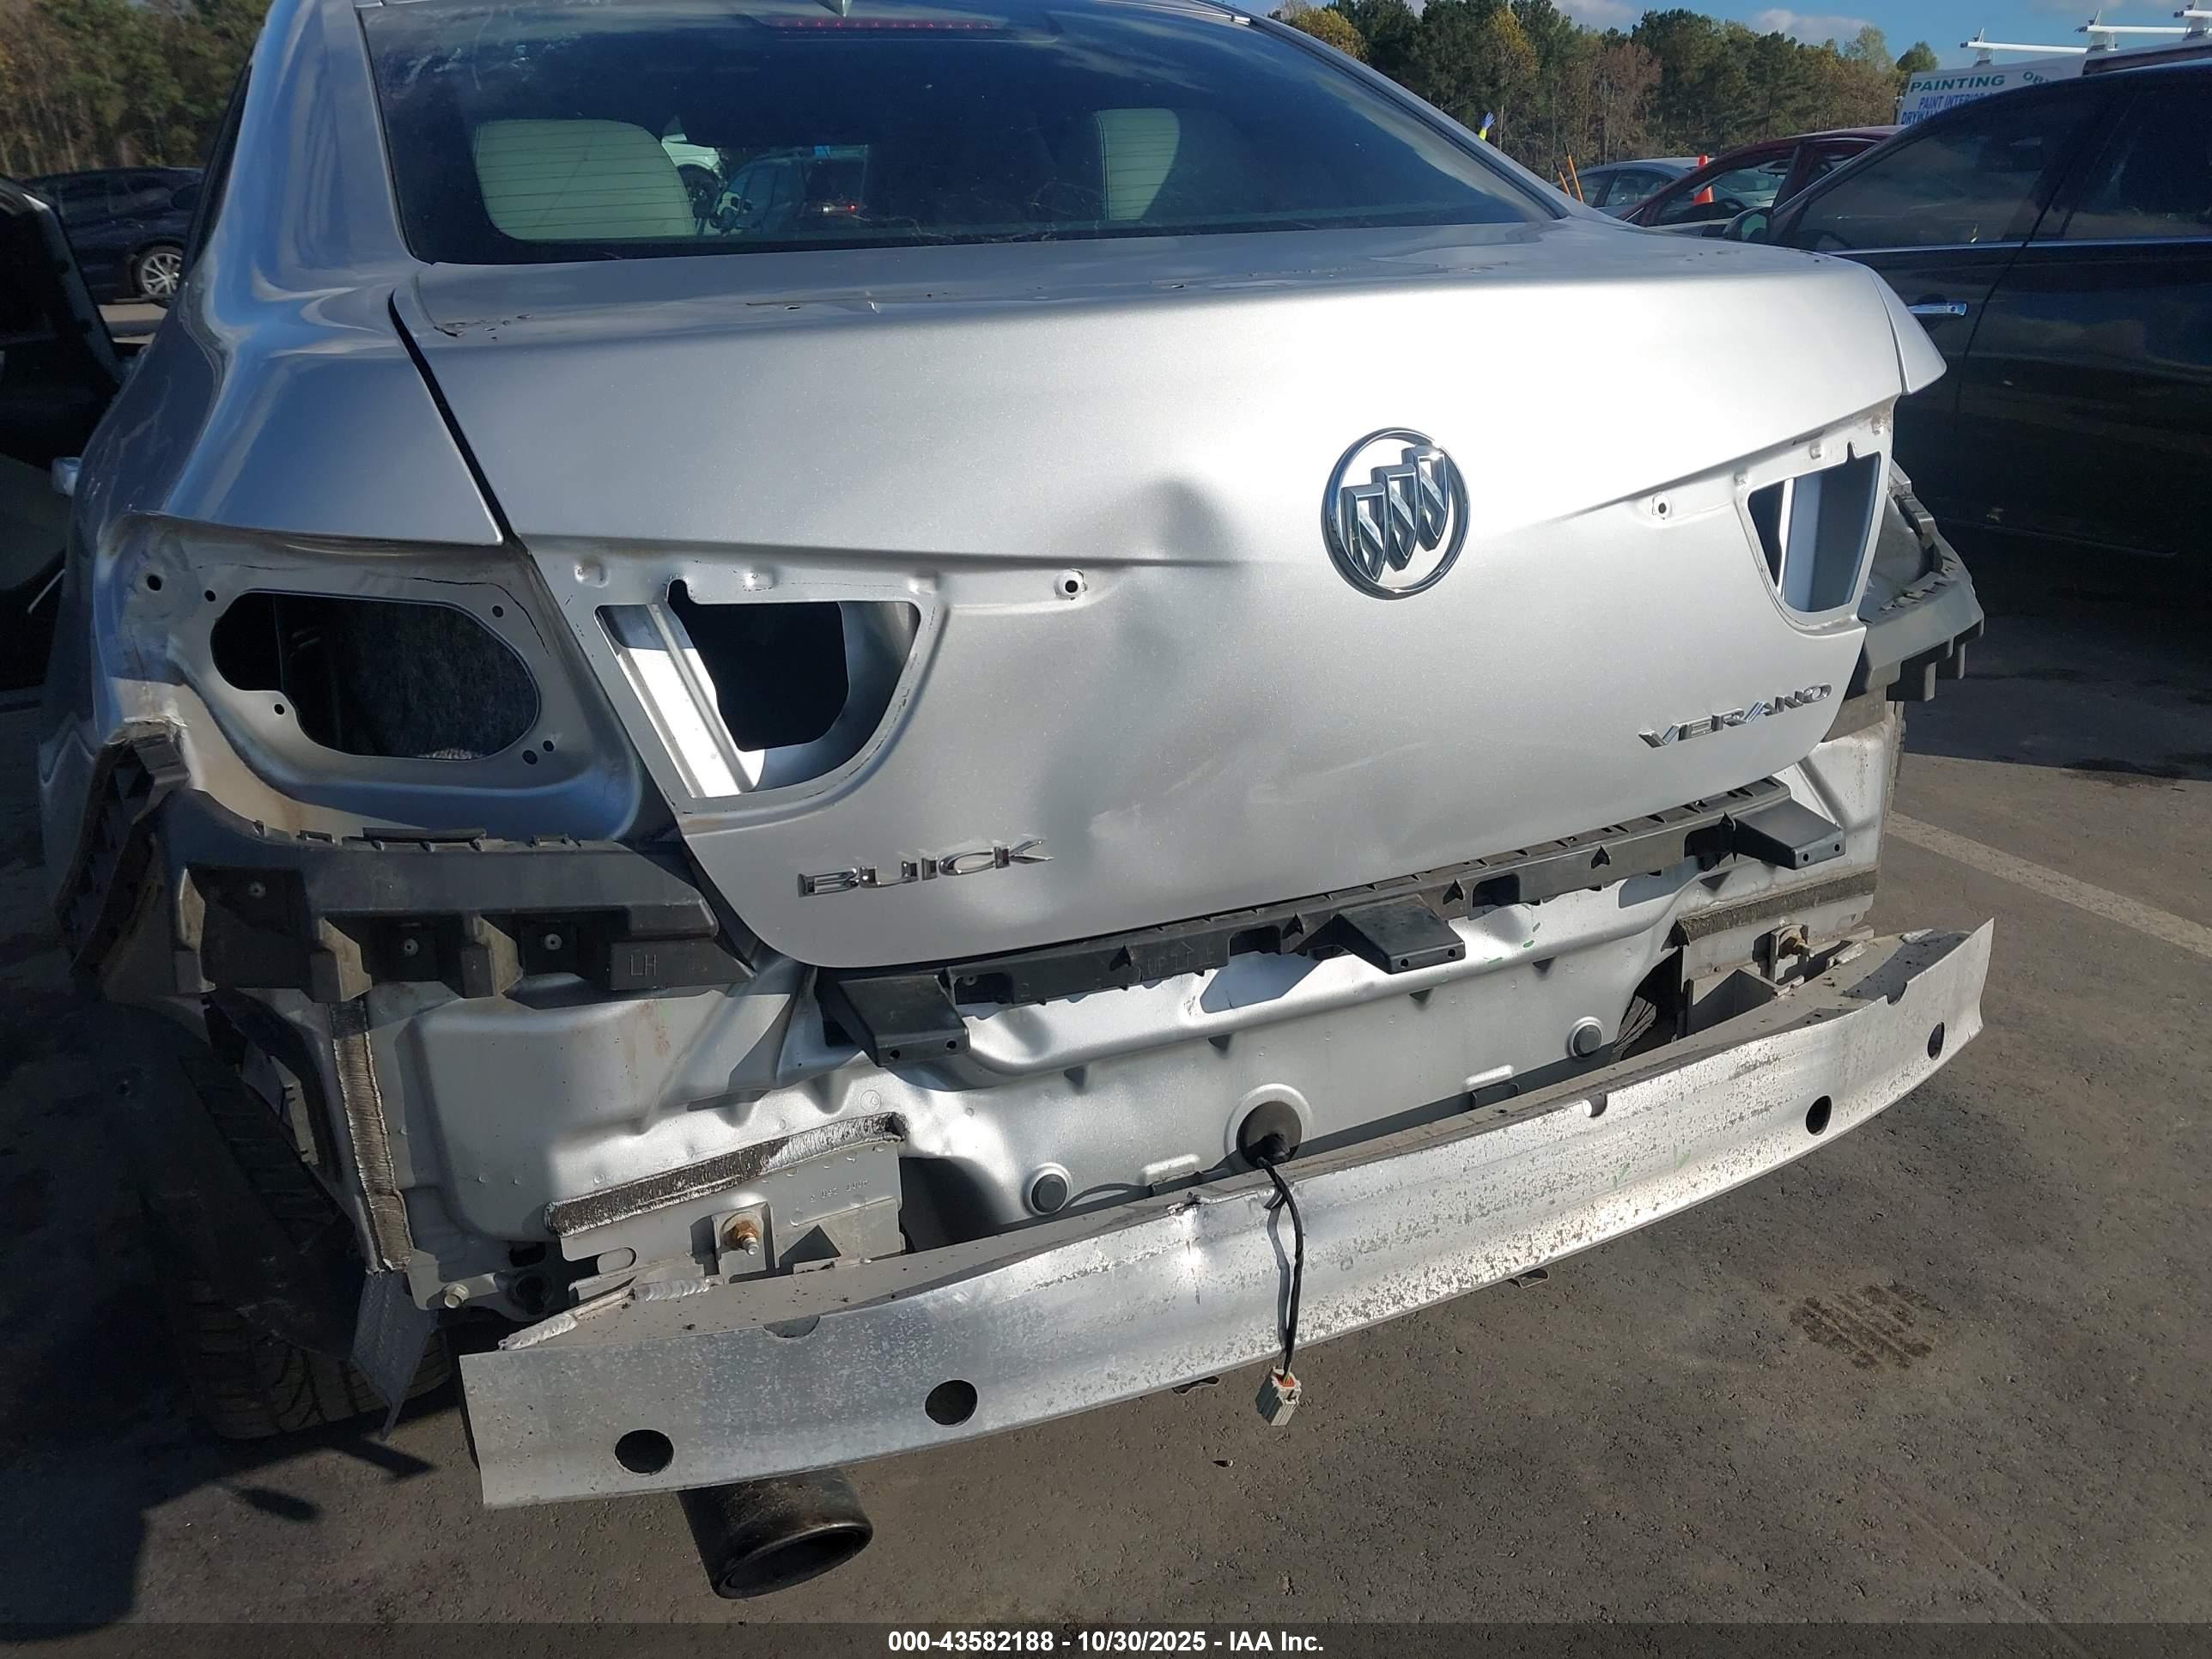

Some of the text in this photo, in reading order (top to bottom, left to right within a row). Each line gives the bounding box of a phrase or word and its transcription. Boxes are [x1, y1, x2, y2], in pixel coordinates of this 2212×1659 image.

[1910, 75, 2006, 93] PAINTING
[1917, 95, 1944, 110] PAINT
[1638, 682, 1832, 749] VERANO
[797, 838, 1054, 897] BUICK
